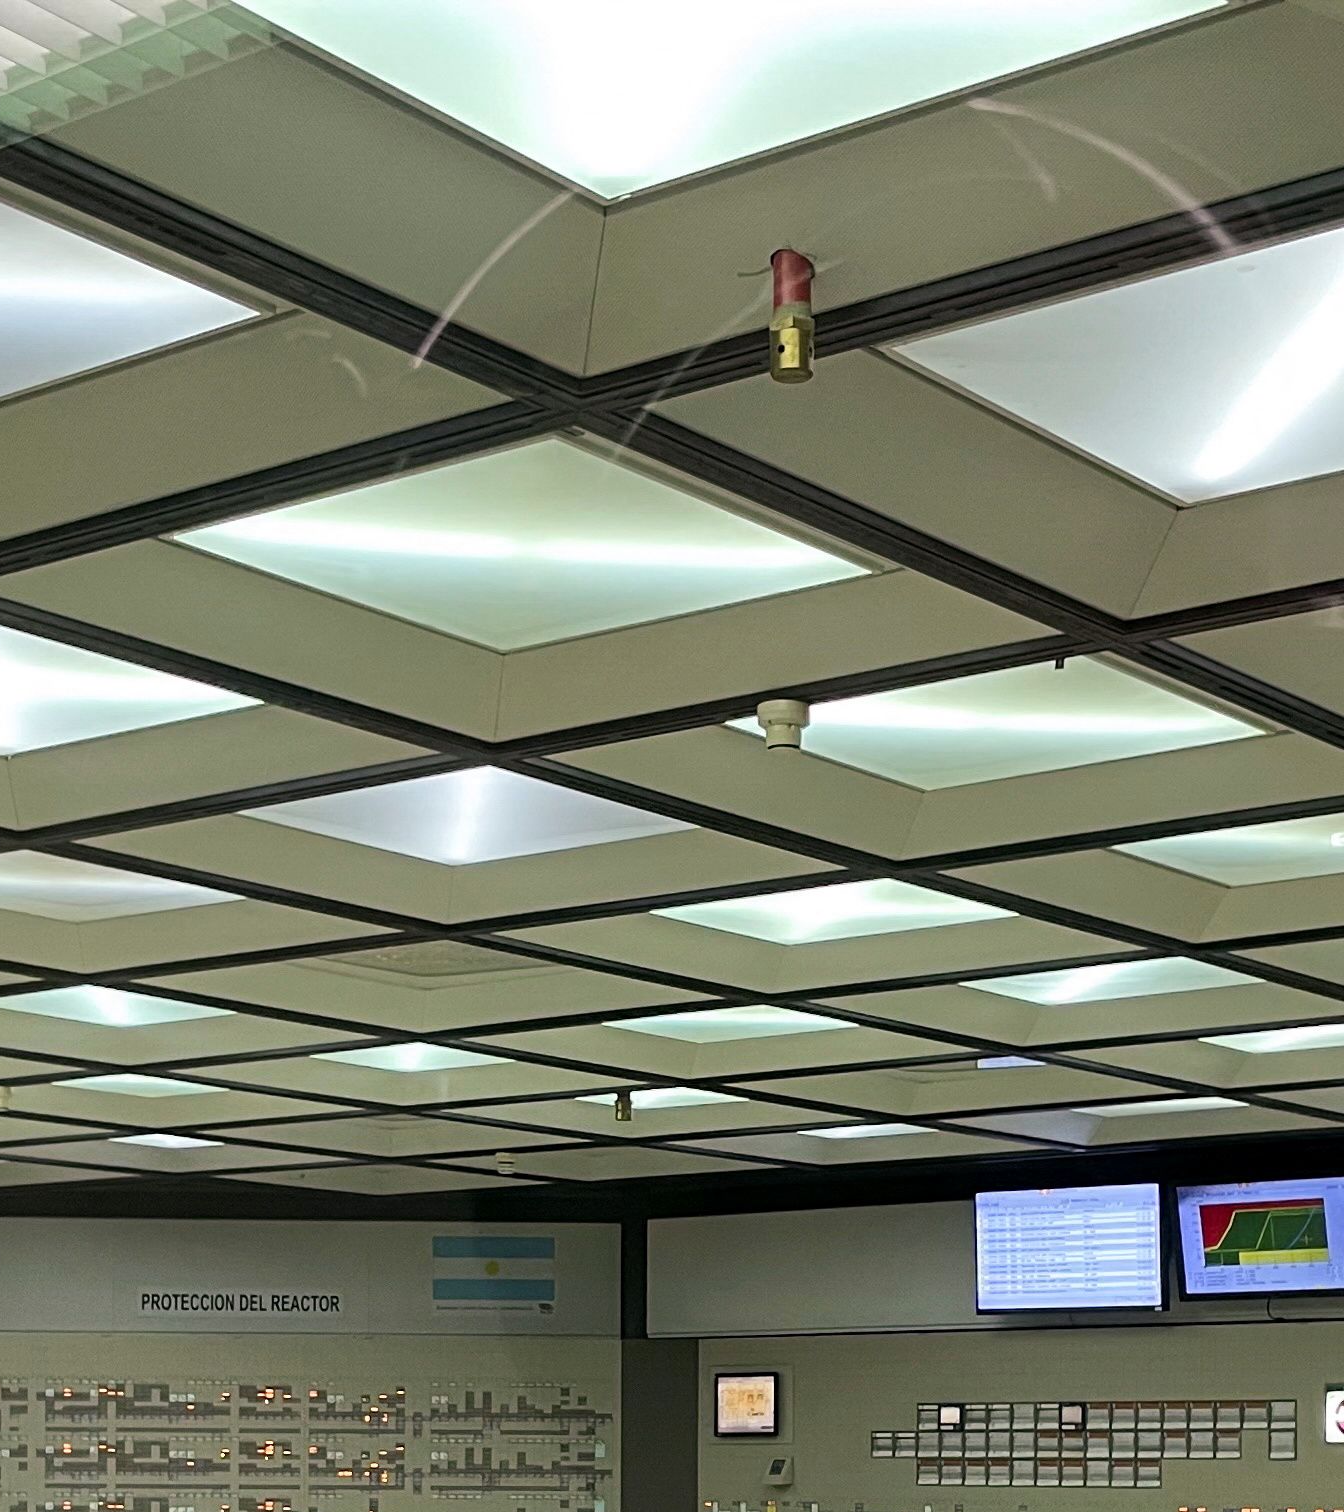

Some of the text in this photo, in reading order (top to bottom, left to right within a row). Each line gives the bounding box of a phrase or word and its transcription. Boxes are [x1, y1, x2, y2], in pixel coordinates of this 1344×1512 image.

[141, 1293, 340, 1312] PROTECCION DEL REACTOR
